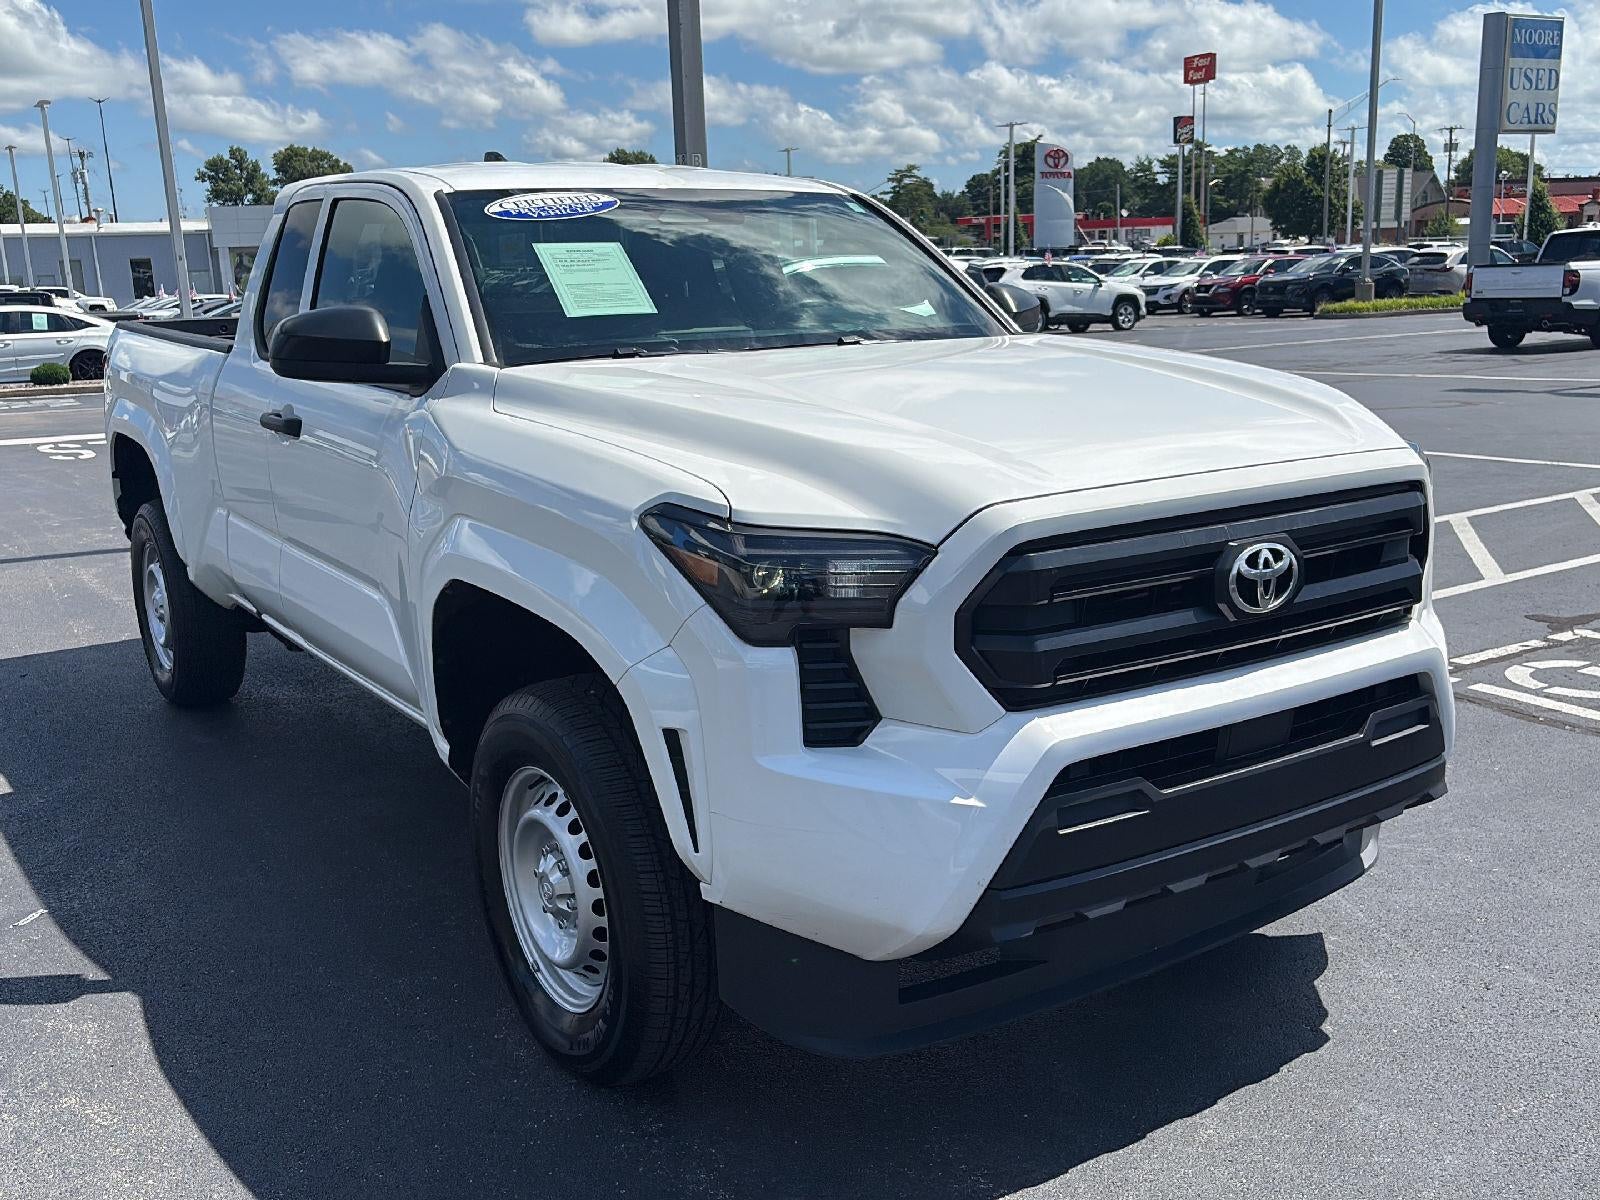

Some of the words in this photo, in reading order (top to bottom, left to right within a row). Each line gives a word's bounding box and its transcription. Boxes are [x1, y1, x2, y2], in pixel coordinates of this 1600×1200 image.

[1513, 28, 1560, 45] MOORE
[1188, 68, 1206, 80] Fuel
[1509, 67, 1560, 91] USED
[1506, 101, 1557, 125] CARS
[1040, 171, 1072, 179] TOYOTA
[499, 193, 601, 210] CERTIFIED
[527, 203, 596, 218] VEHICLE
